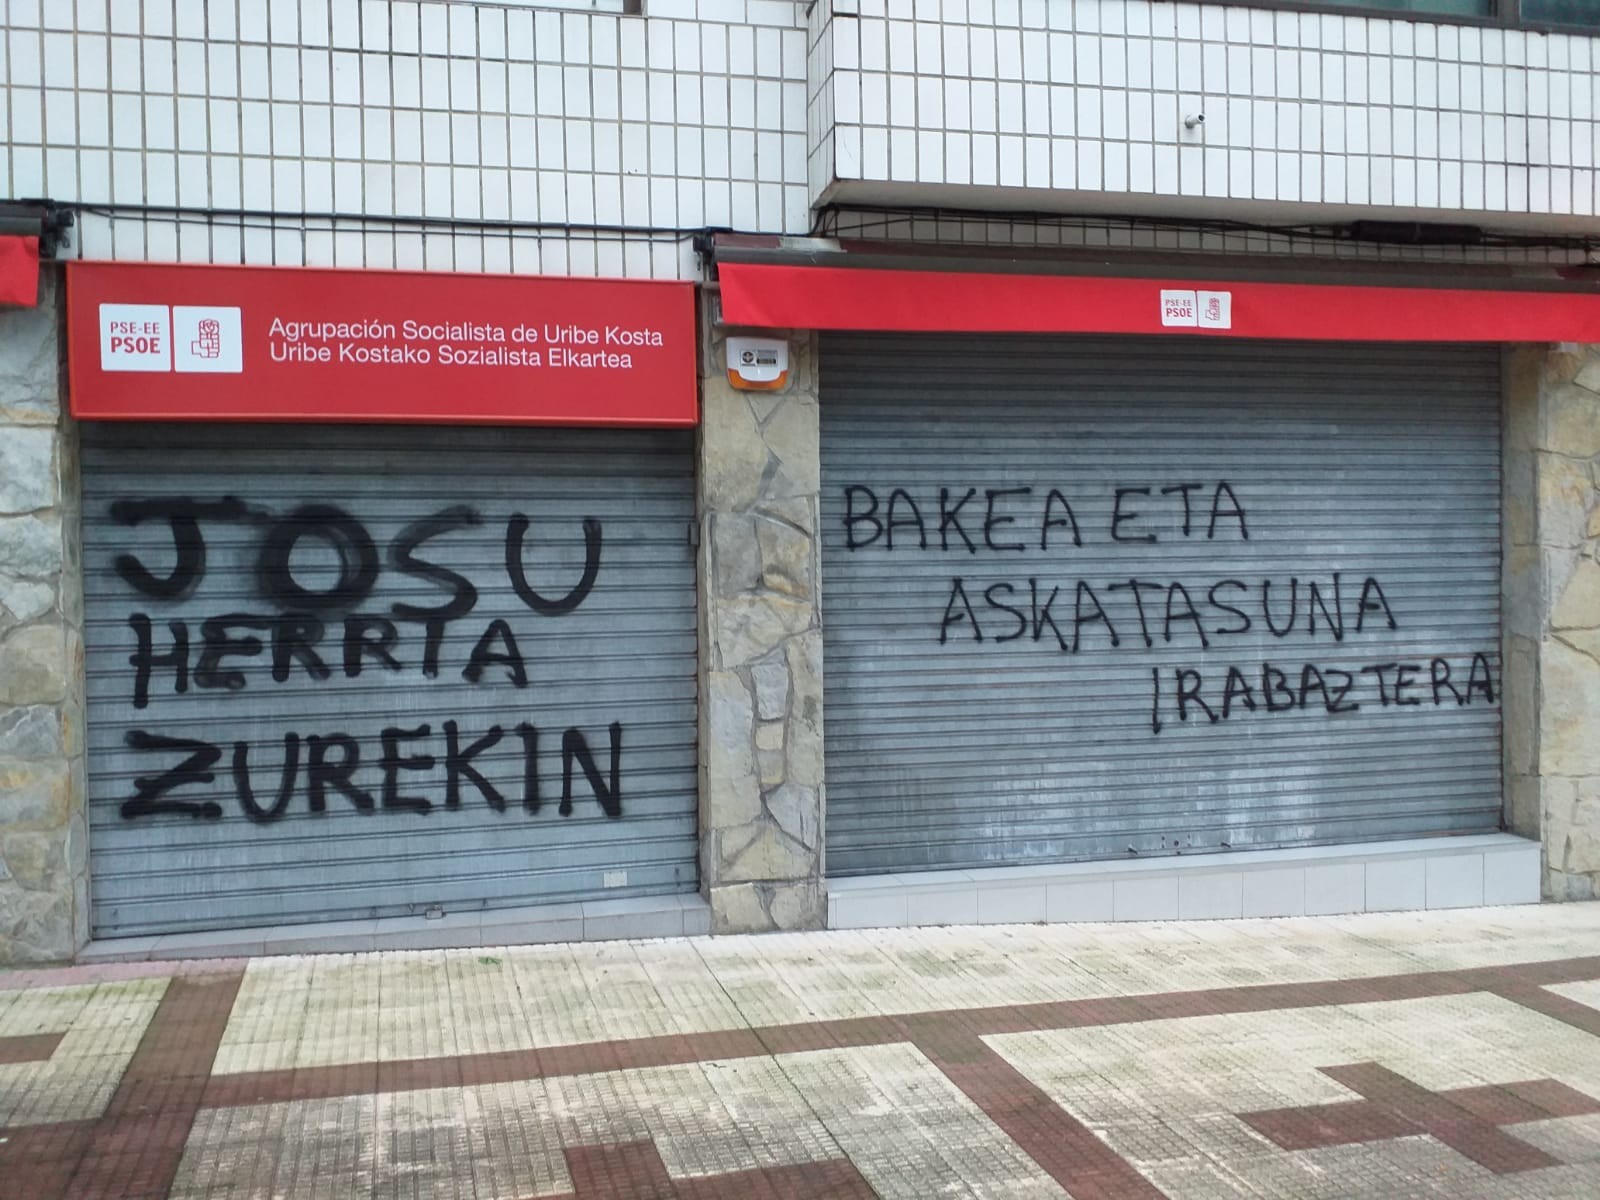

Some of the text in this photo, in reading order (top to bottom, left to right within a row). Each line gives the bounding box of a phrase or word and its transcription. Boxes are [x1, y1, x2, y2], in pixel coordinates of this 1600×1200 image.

[1165, 298, 1193, 307] PSE-EE
[1166, 307, 1193, 318] PSOE
[110, 321, 161, 335] PSE-EE
[268, 317, 664, 347] Agrupación Socialista de Uribe Kosta
[110, 336, 161, 354] PSOE
[269, 341, 633, 369] Uribe Kostako Sozialista Elkartea
[842, 480, 1250, 555] BAKEA ETA
[110, 496, 602, 616] JOSU
[938, 571, 1399, 653] ASKATASUNA
[1151, 651, 1500, 735] IRABAZTERA
[120, 720, 622, 822] ZUREKIN
